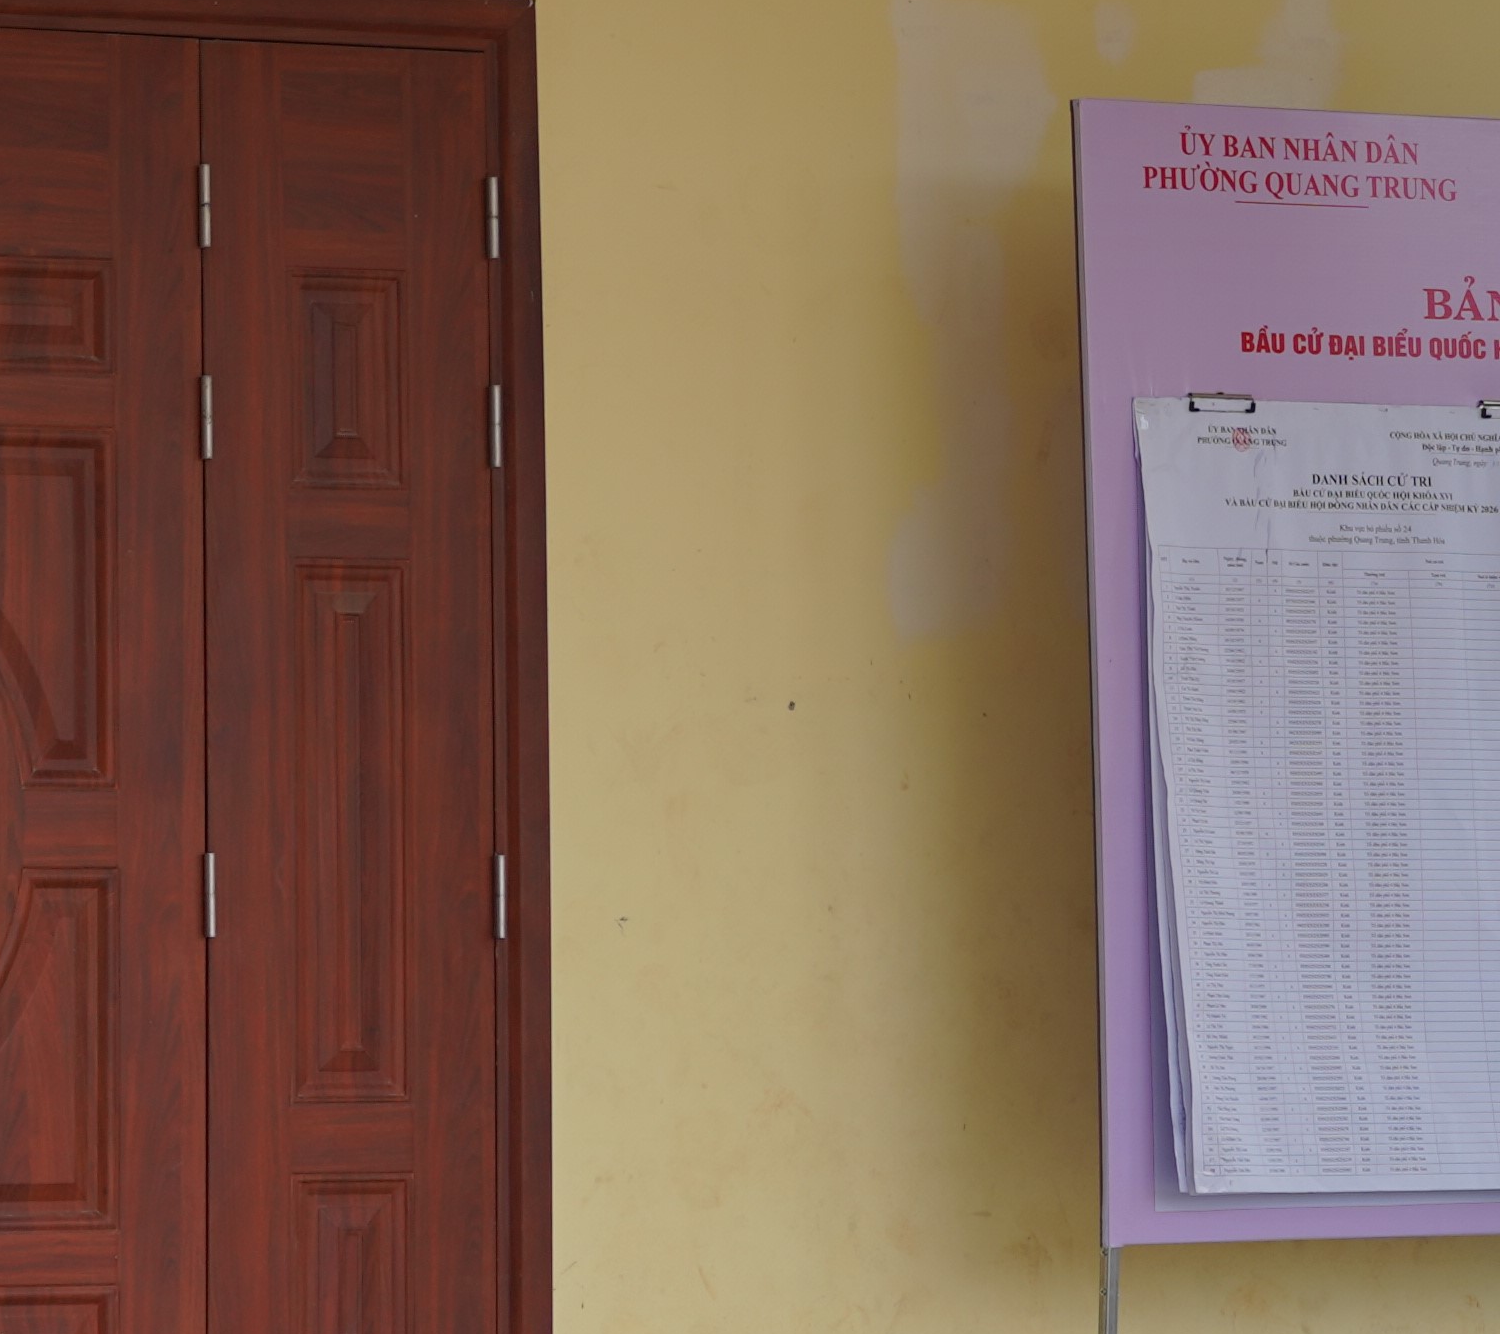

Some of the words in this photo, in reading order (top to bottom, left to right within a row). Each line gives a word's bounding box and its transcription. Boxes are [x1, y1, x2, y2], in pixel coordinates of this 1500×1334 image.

[1179, 125, 1215, 157] ỦY
[1224, 135, 1275, 159] BAN
[1284, 132, 1356, 163] NHÂN
[1366, 133, 1419, 165] DÂN
[1143, 161, 1257, 193] PHƯỜNG
[1265, 175, 1359, 200] QUANG
[1366, 176, 1457, 202] TRUNG
[1240, 325, 1284, 353] BẦU
[1293, 326, 1324, 355] CỬ
[1328, 336, 1364, 363] ĐẠI
[1374, 329, 1422, 357] BIỂU
[1430, 332, 1486, 360] QUỐC
[1312, 474, 1347, 485] DANH
[1411, 476, 1432, 487] TRI
